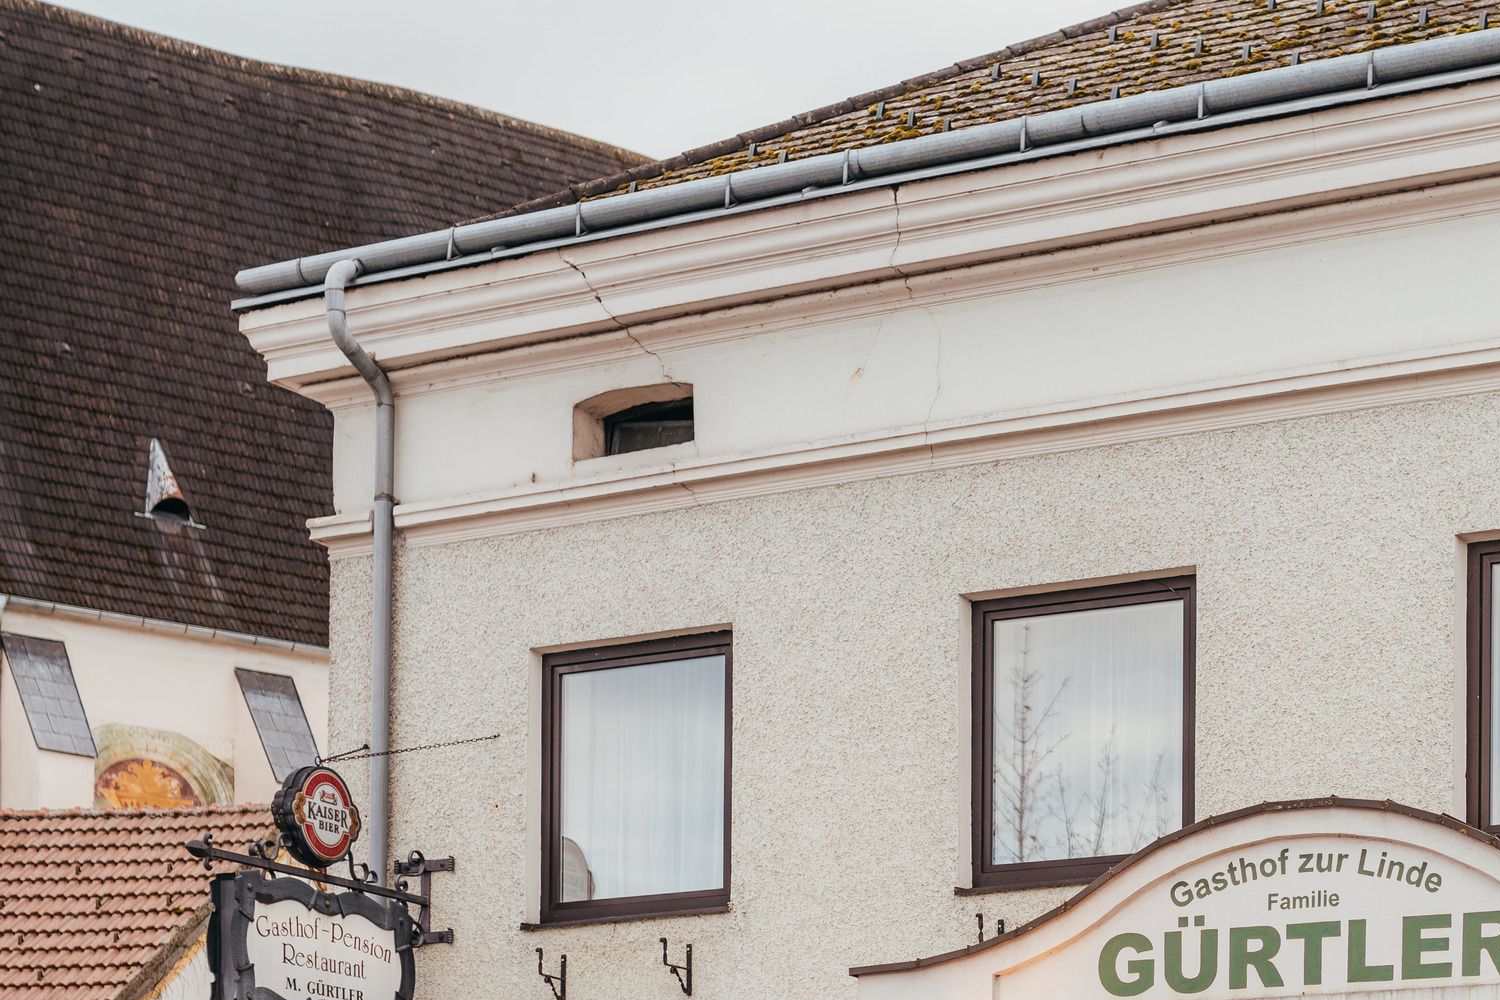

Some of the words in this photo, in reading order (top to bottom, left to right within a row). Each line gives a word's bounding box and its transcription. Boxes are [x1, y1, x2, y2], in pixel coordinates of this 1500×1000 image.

[308, 800, 349, 830] KAISER
[318, 819, 340, 835] BIER
[1169, 848, 1290, 908] Gasthof
[1298, 852, 1349, 875] zur
[1357, 848, 1444, 894] Linde
[1267, 891, 1341, 912] Familie
[282, 943, 367, 980] Restaurant
[285, 976, 301, 992] M.
